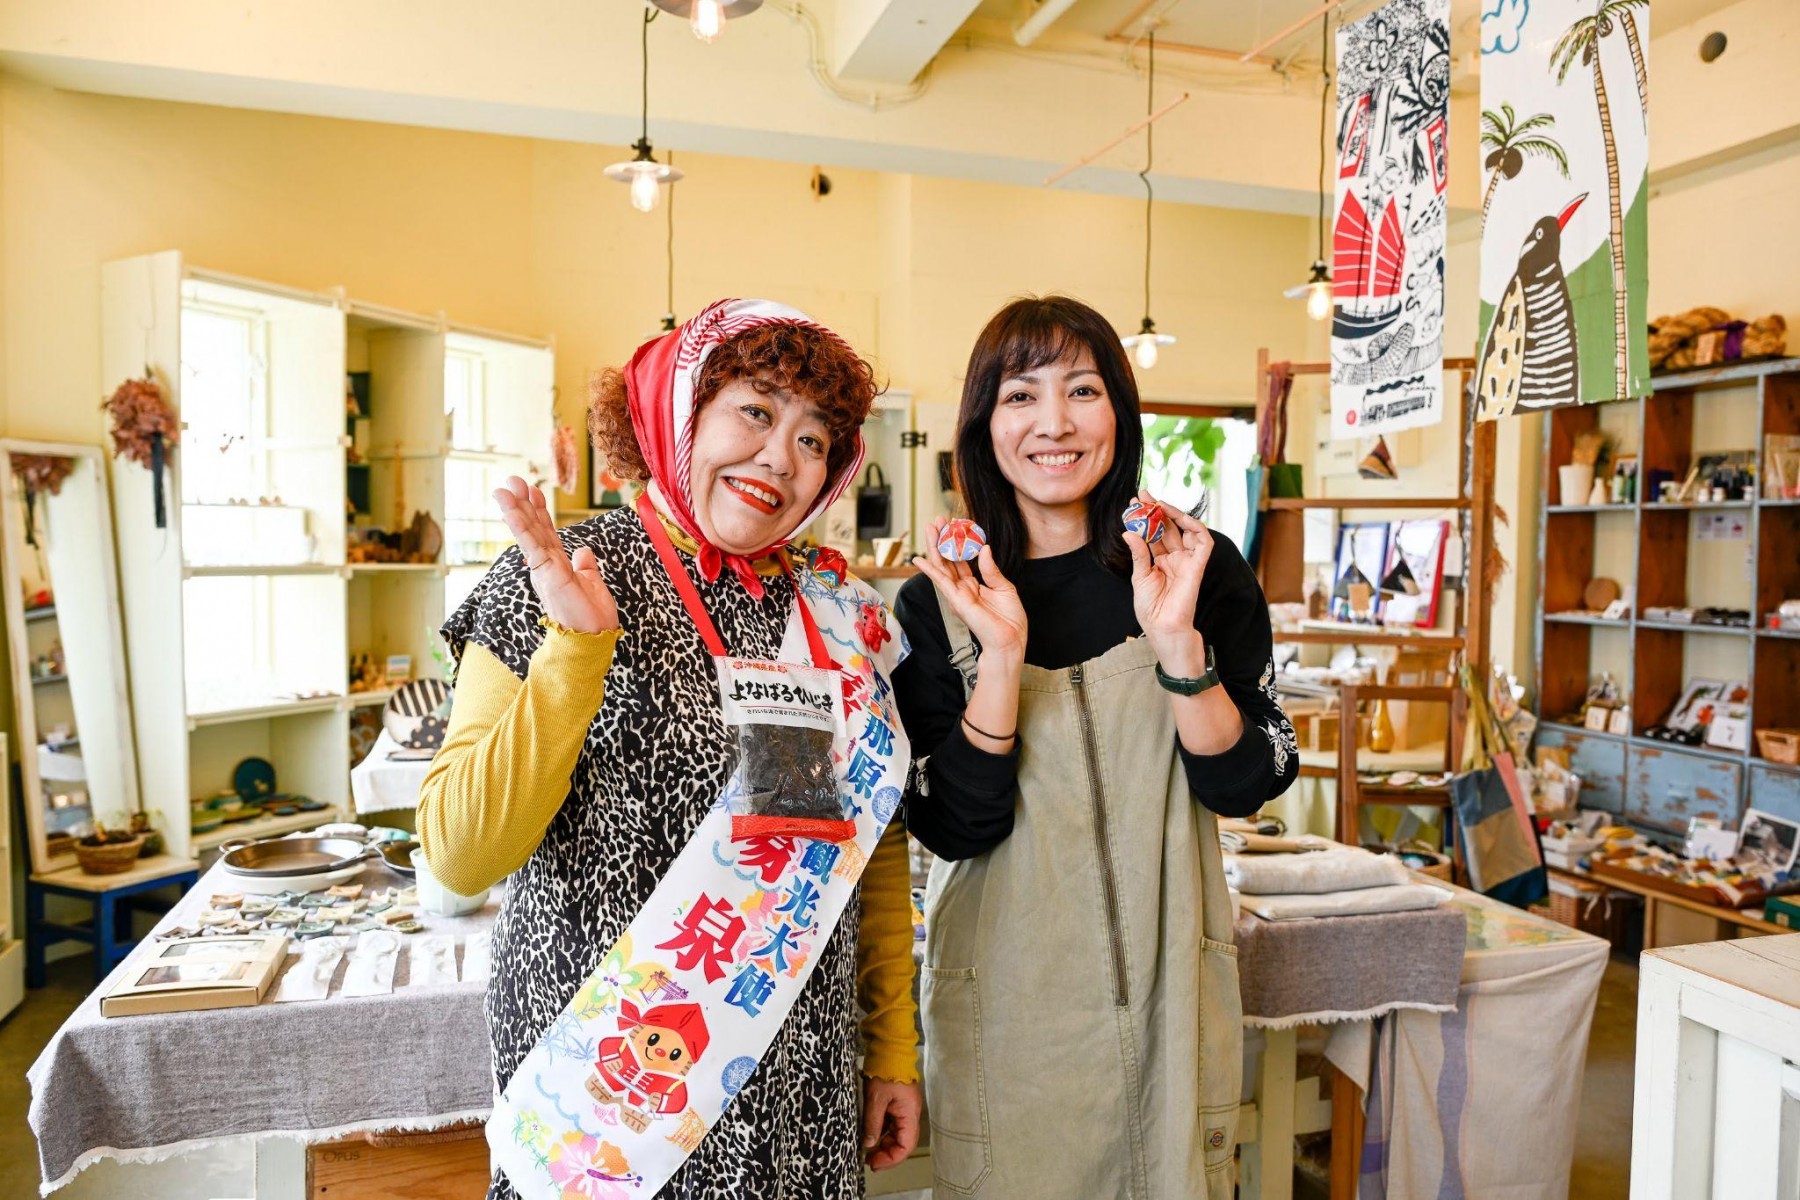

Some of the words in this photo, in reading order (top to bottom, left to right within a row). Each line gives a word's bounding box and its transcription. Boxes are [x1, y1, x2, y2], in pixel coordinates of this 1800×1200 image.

[729, 679, 833, 713] よなばるひじき
